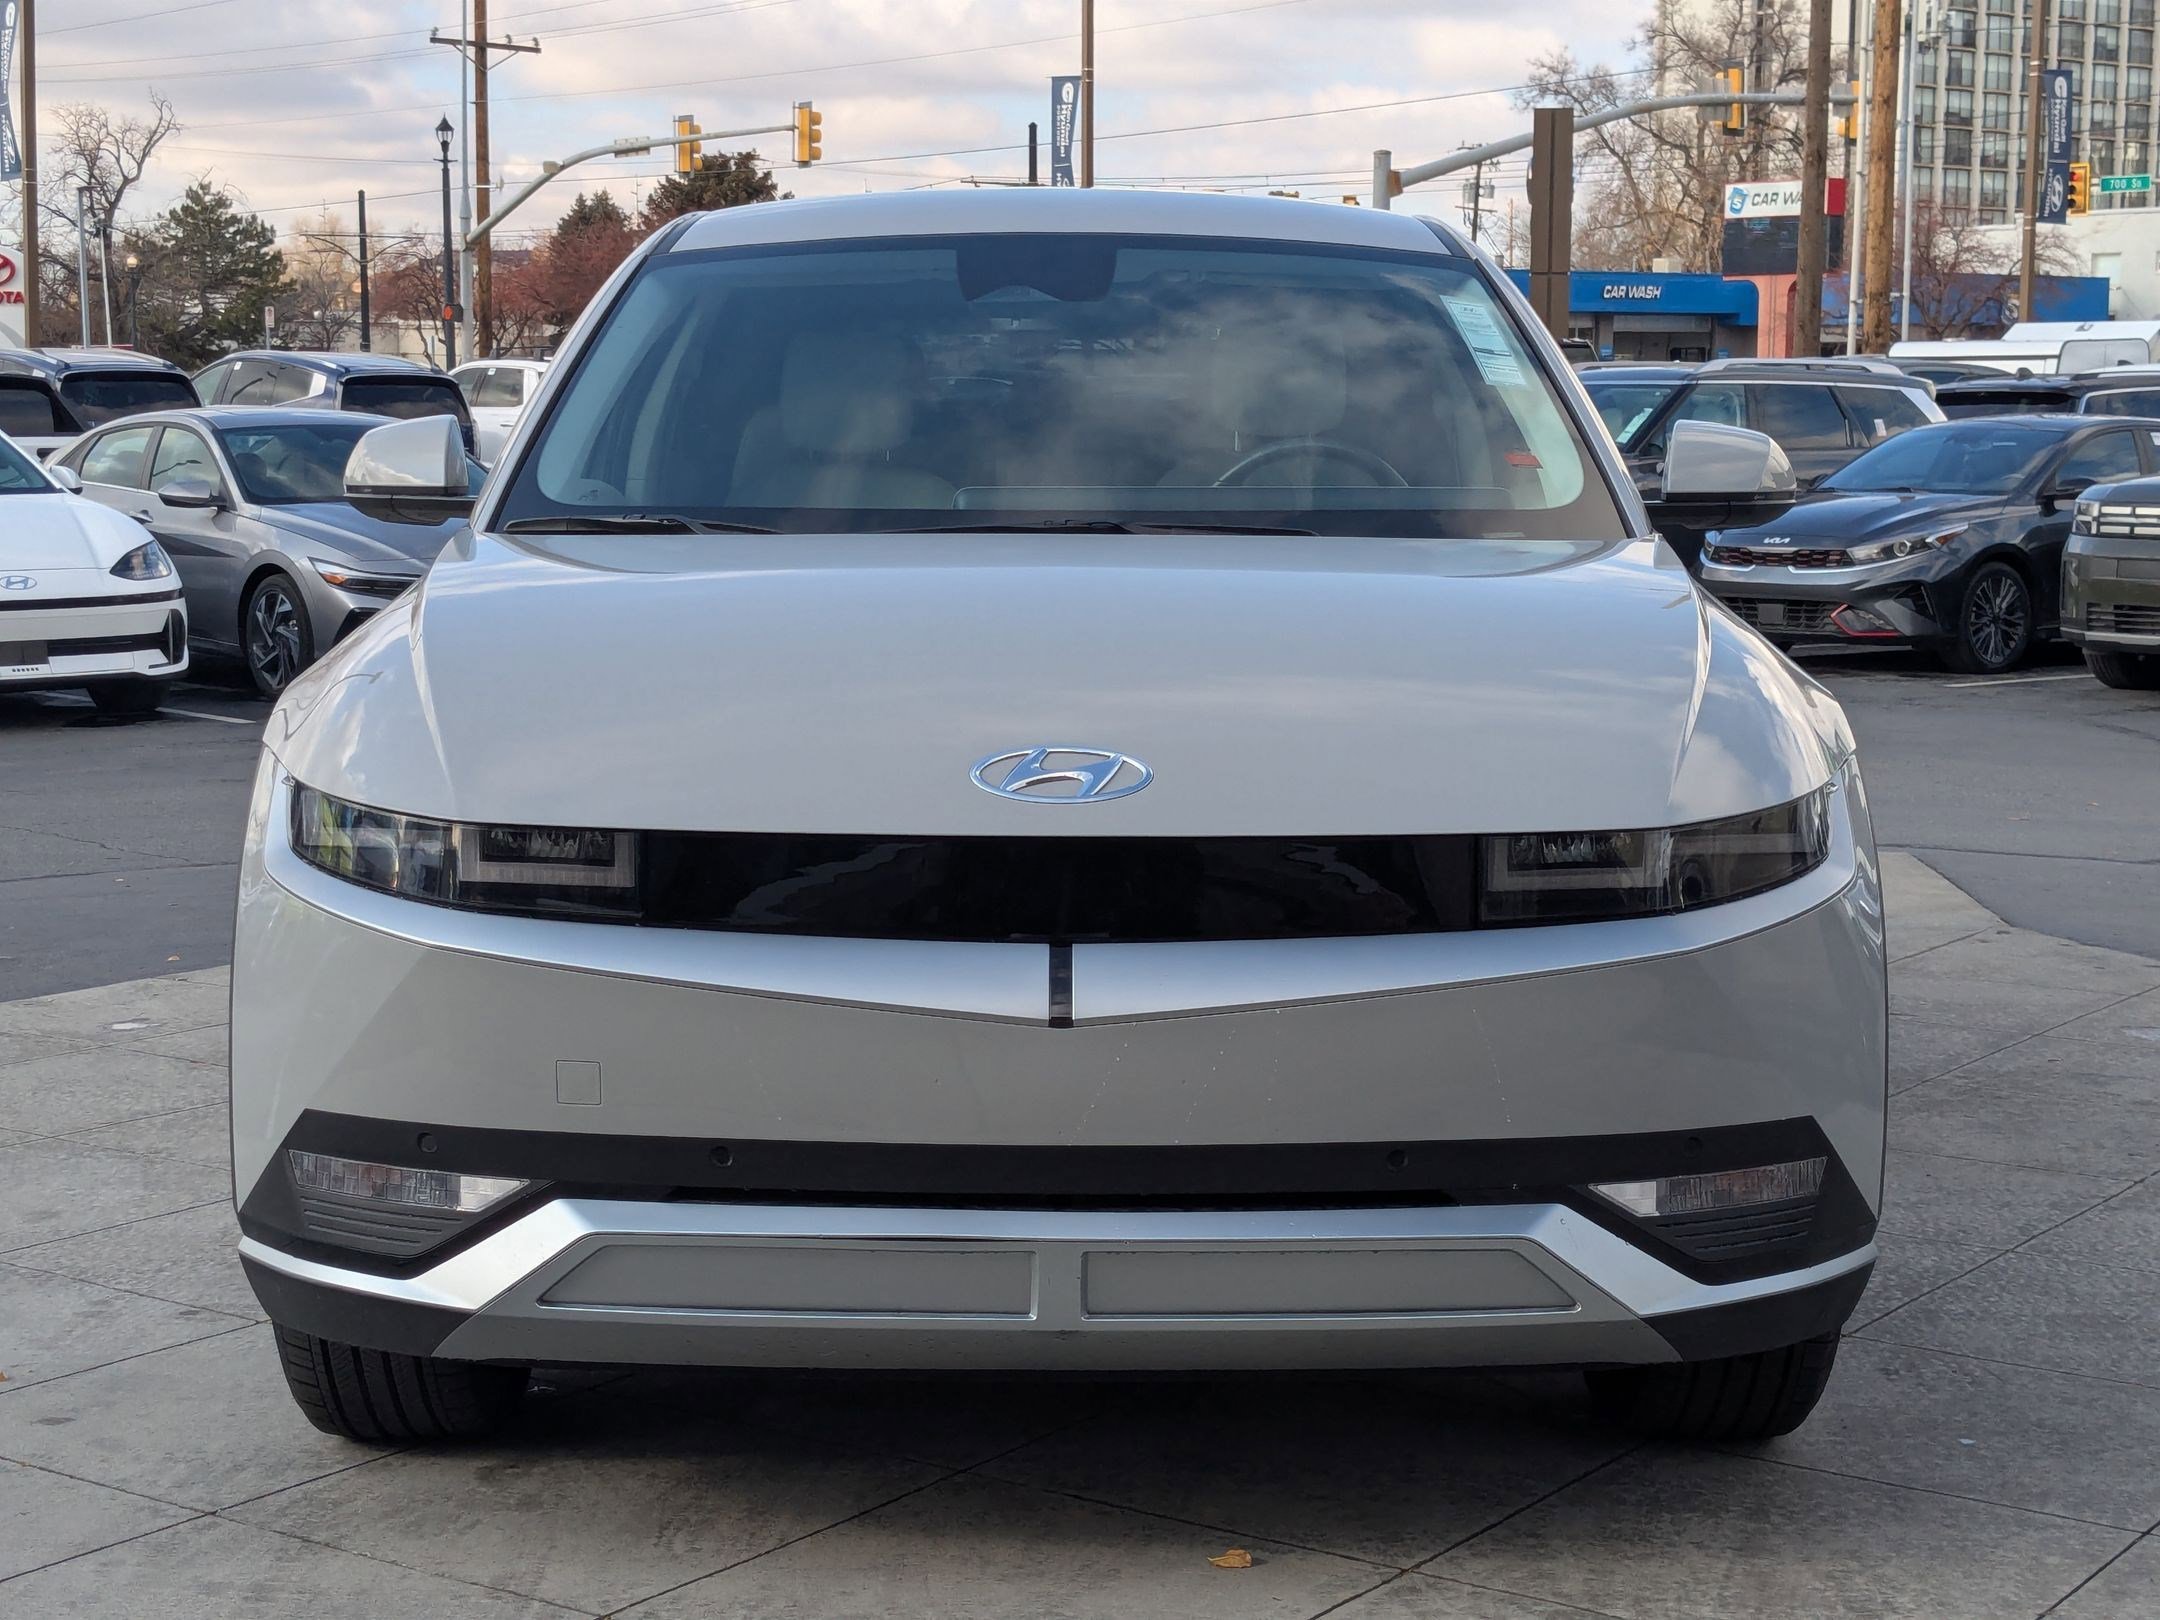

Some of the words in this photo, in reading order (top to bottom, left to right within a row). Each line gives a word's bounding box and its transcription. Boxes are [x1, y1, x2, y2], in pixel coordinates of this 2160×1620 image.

[2109, 179, 2127, 189] 700
[1751, 192, 1780, 207] CAR
[1603, 285, 1627, 299] CAR
[1628, 285, 1662, 299] WASH
